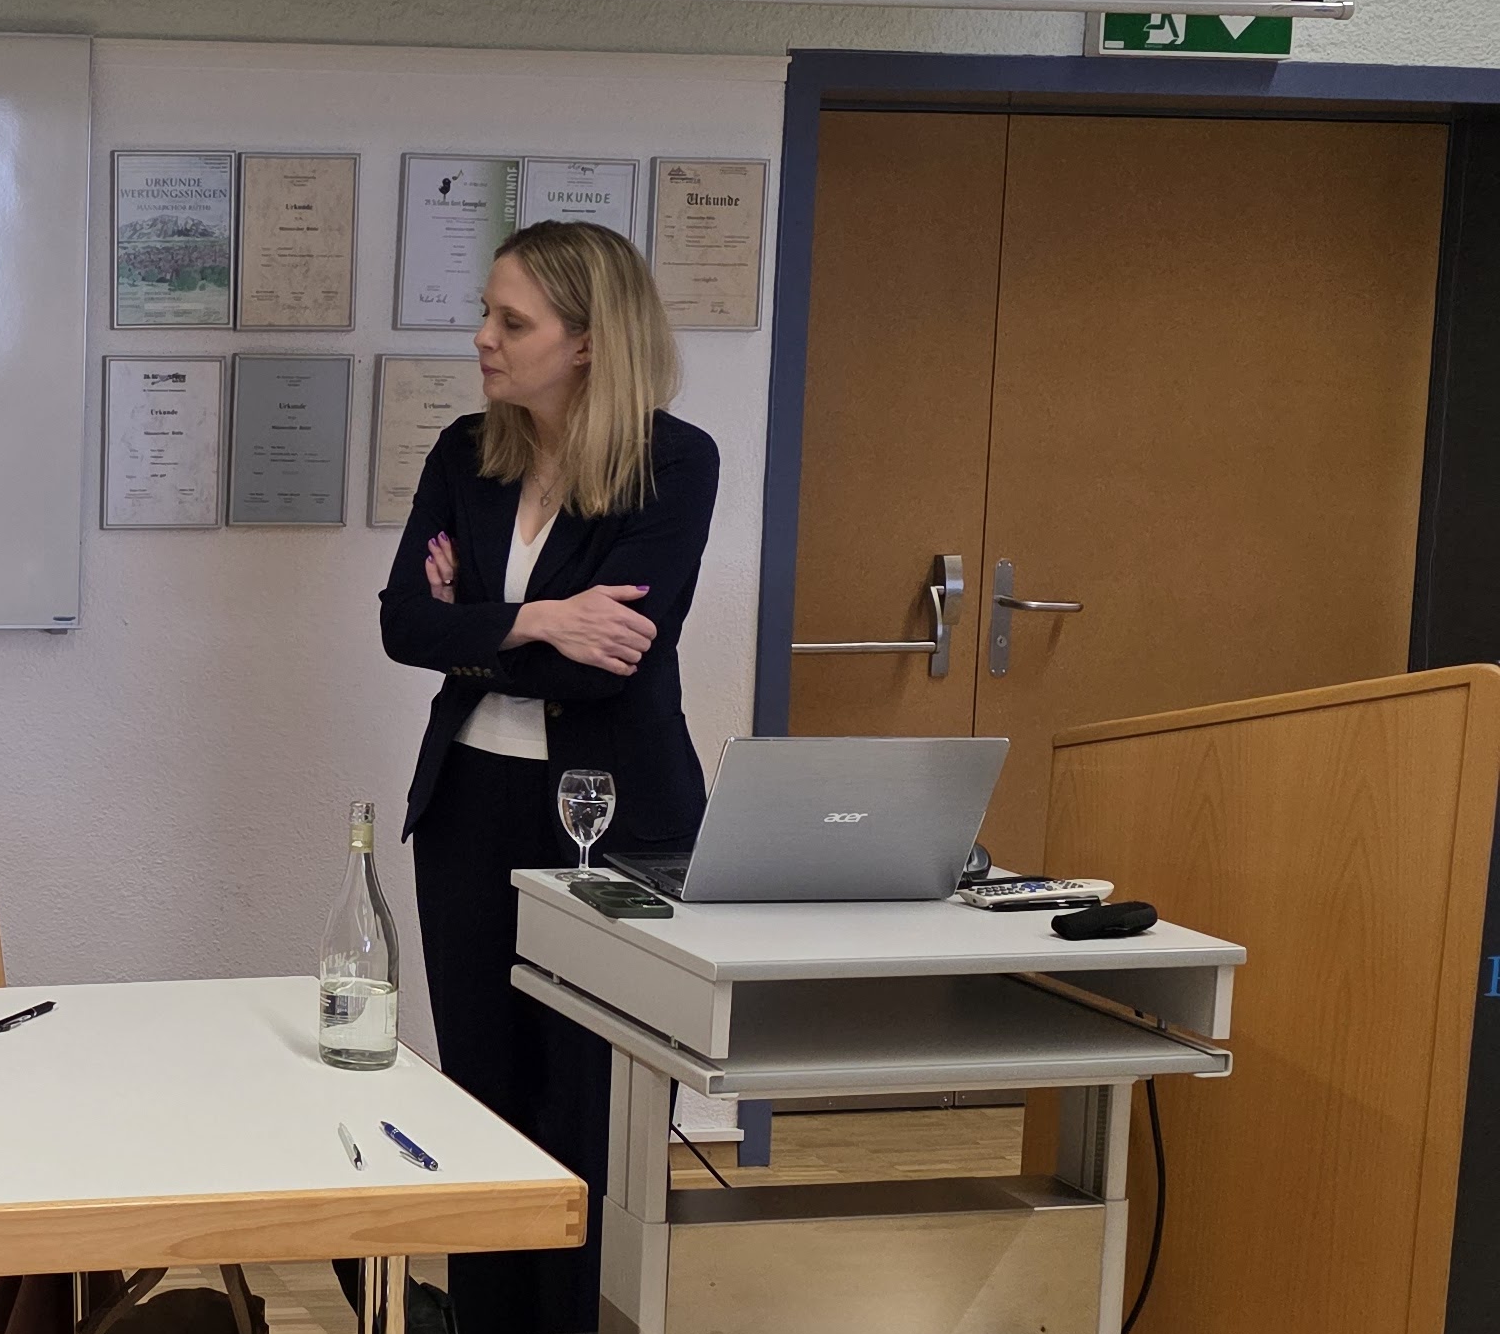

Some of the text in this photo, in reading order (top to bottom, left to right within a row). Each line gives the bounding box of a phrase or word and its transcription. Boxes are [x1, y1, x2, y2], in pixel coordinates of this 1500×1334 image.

[145, 177, 203, 188] URKUNDE
[120, 188, 227, 199] WERTUNGSSINGEN
[547, 191, 611, 204] URKUNDE
[686, 192, 740, 207] Urkunde
[823, 812, 869, 823] acer
